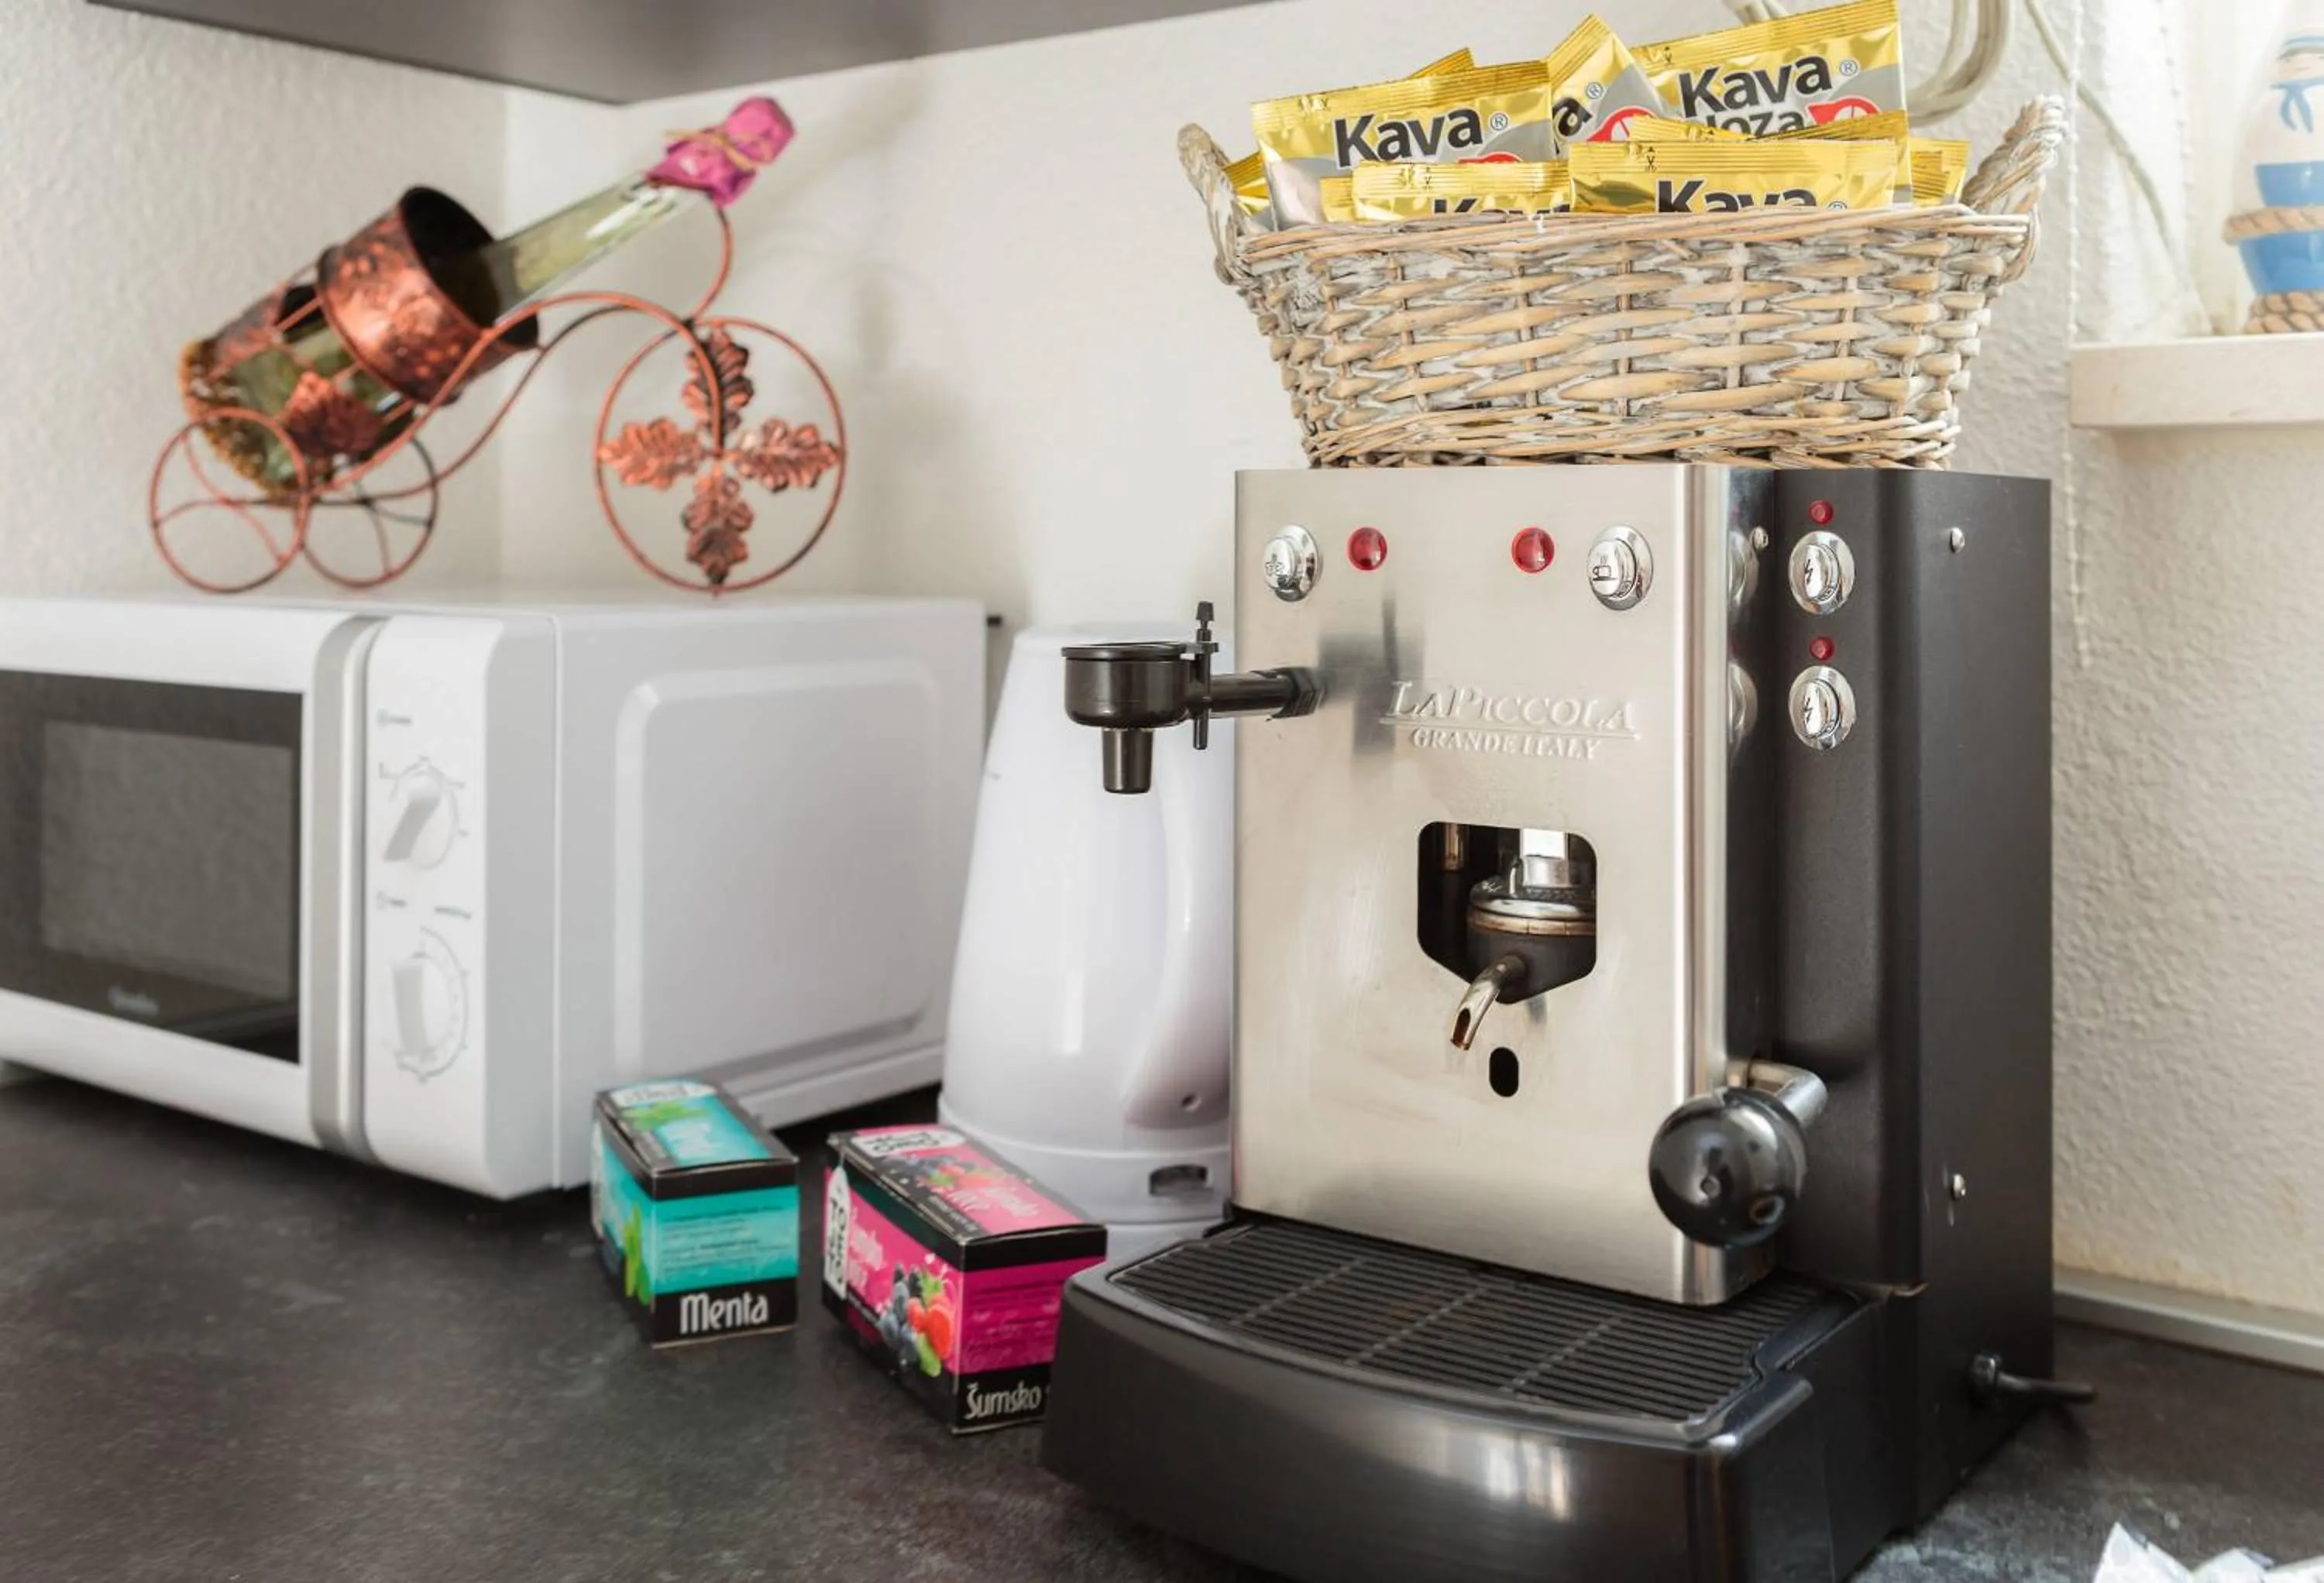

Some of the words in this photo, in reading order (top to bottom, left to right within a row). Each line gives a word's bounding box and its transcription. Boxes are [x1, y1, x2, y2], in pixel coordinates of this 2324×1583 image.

[1679, 56, 1833, 118] Kava
[1334, 108, 1483, 169] Kava
[1411, 728, 1517, 755] GRANDE
[1521, 735, 1601, 761] ITALY
[679, 1291, 769, 1335] Menta
[963, 1380, 1043, 1420] Šumsko
